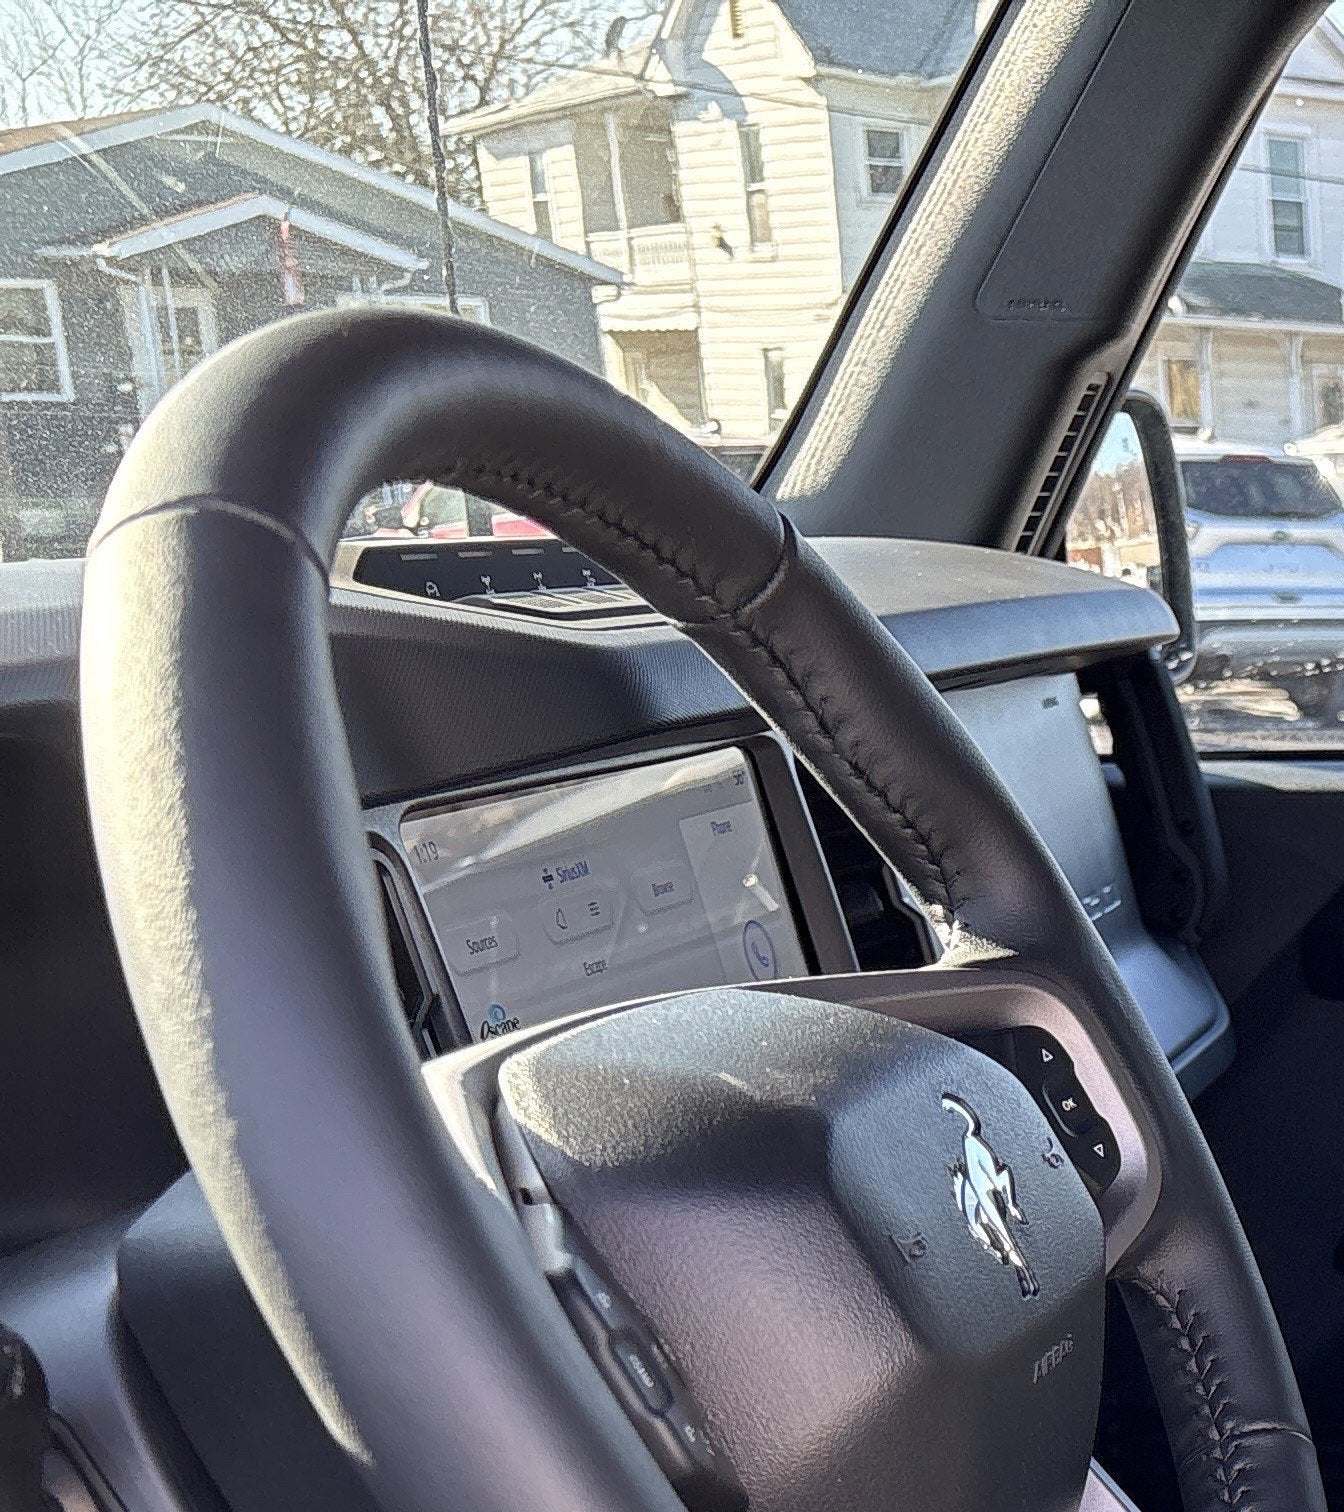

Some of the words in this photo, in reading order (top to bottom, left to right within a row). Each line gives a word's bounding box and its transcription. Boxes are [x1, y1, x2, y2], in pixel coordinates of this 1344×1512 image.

[411, 841, 440, 865] 1:19
[555, 860, 591, 884] SiriusXM
[465, 935, 499, 956] Sources
[1061, 1096, 1078, 1113] OK
